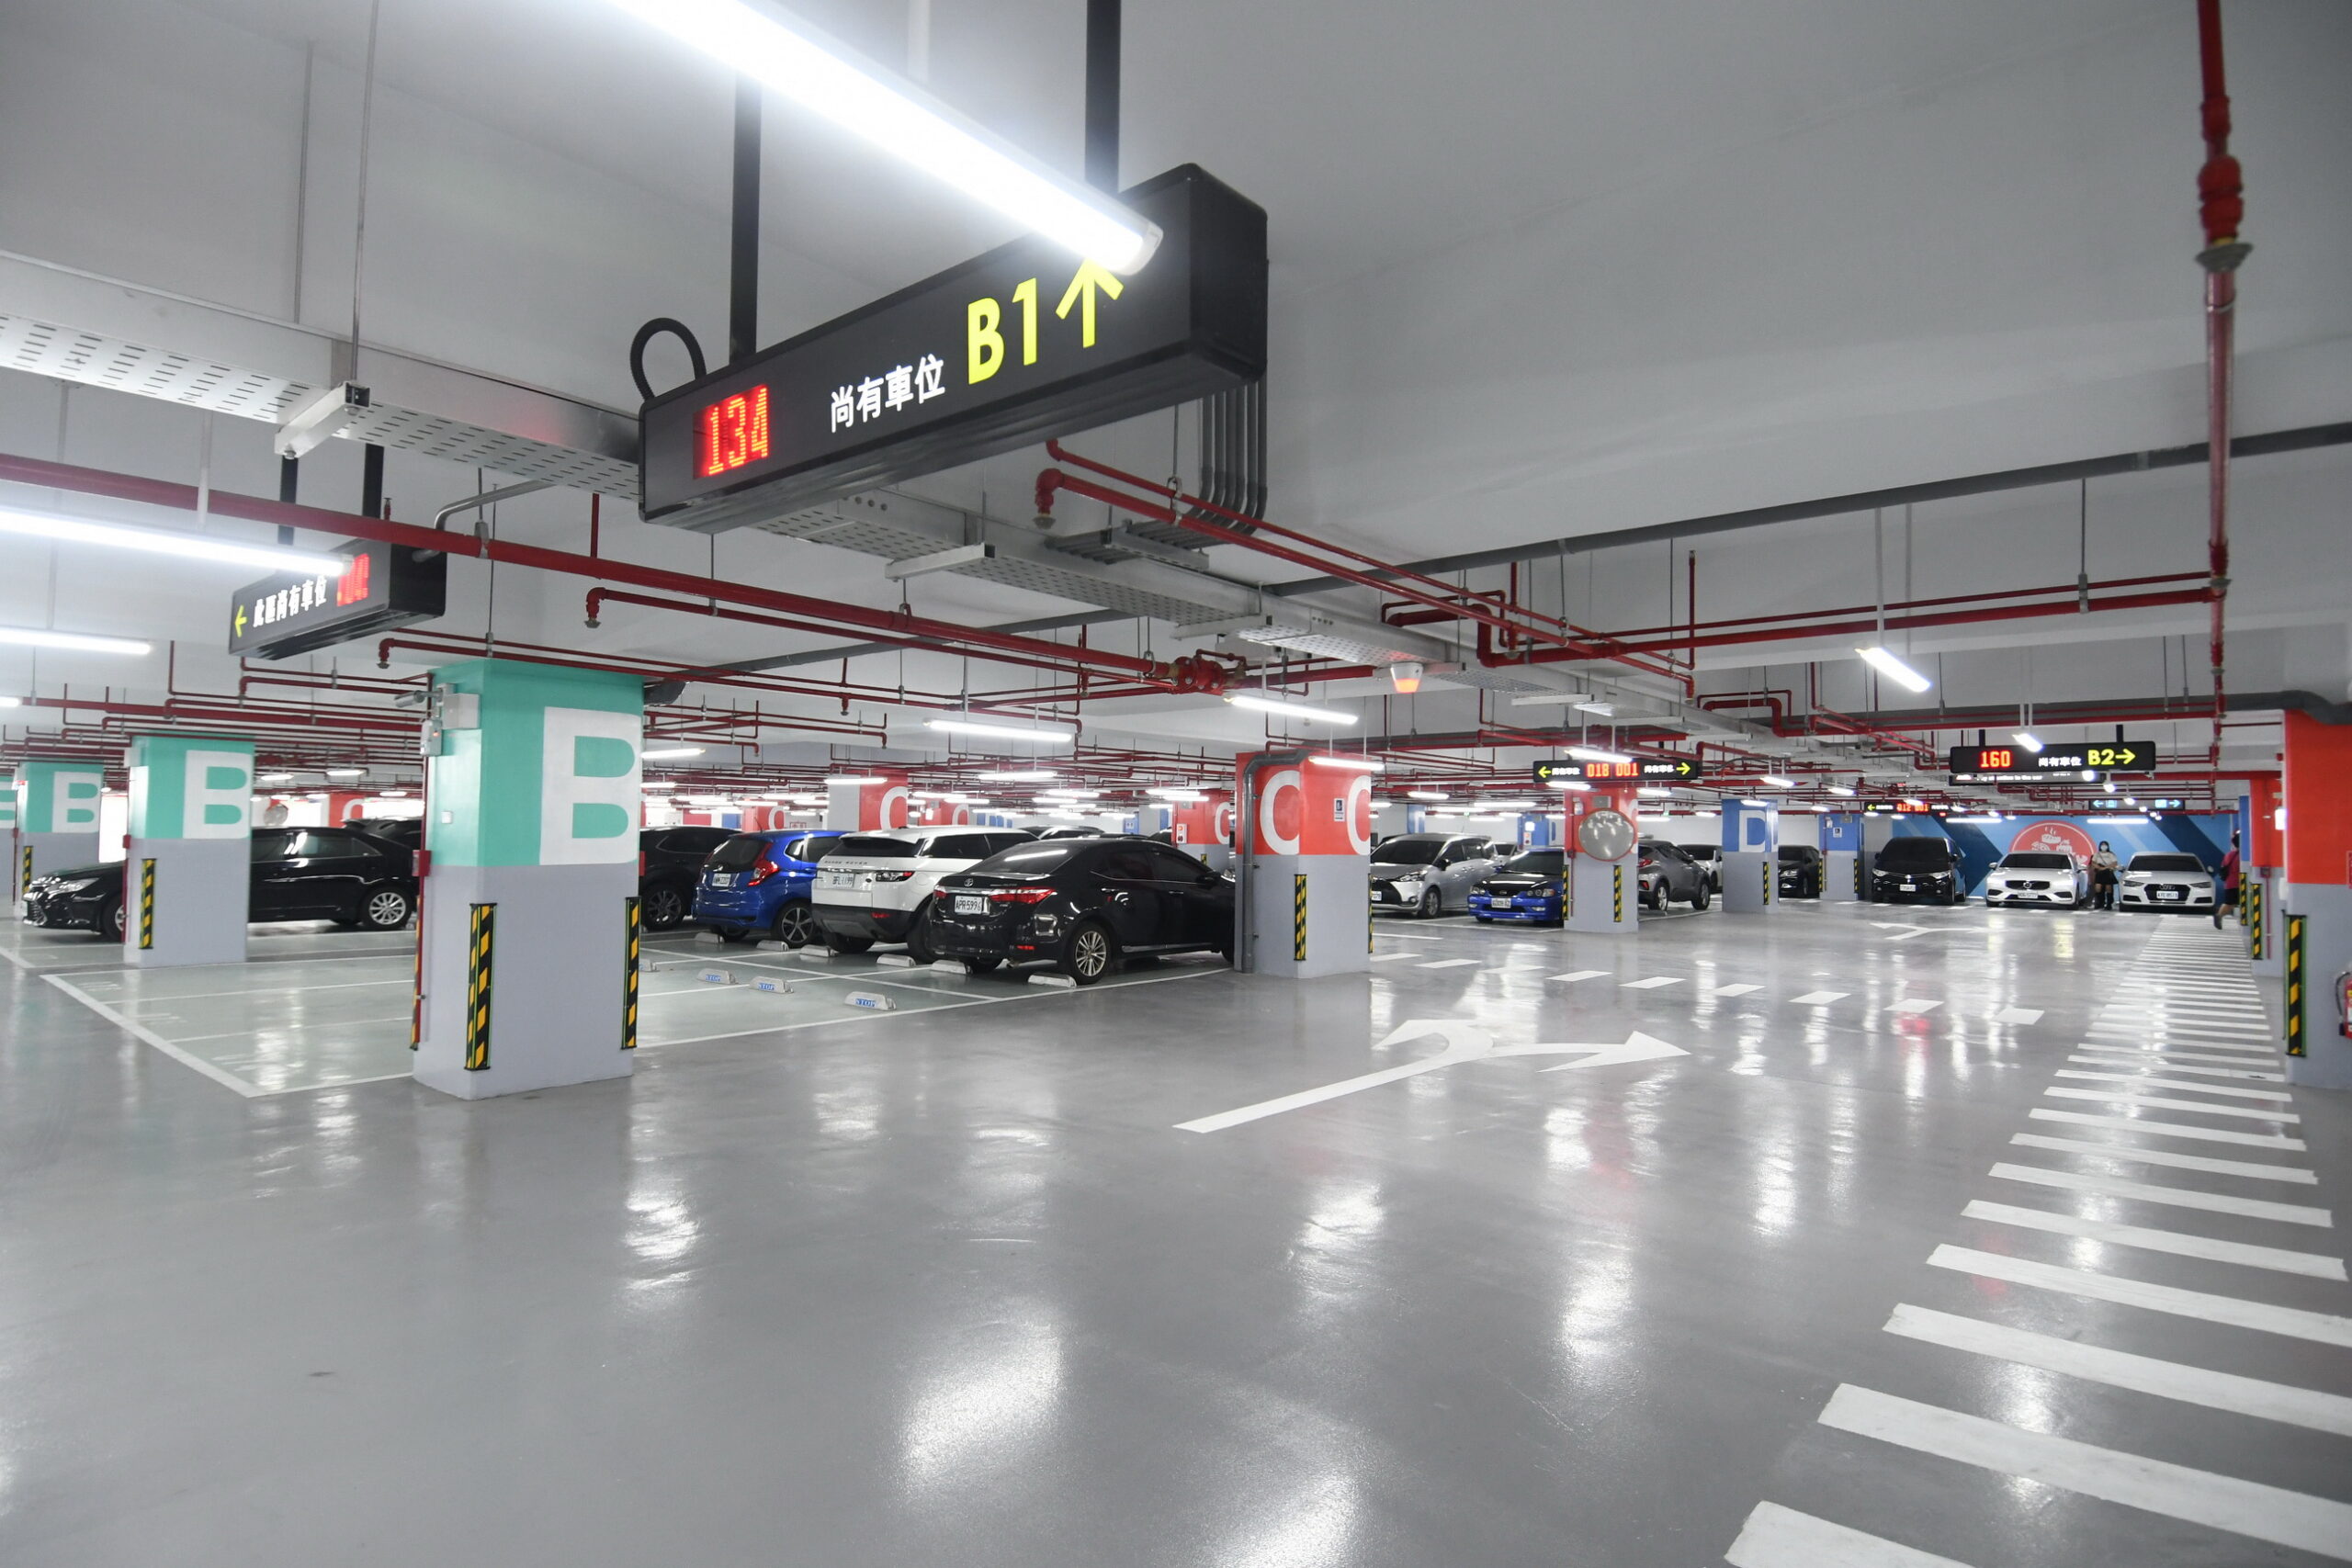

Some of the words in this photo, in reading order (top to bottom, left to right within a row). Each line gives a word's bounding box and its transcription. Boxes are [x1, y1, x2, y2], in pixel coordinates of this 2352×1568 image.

[967, 277, 1037, 385] B1
[708, 386, 768, 476] 134
[830, 354, 946, 434] 尚有車位
[183, 750, 252, 839] B
[539, 706, 642, 865] B
[1980, 750, 2011, 768] 160
[2087, 749, 2115, 765] B2
[52, 772, 102, 833] B
[1260, 770, 1300, 855] C
[1739, 810, 1766, 852] D
[854, 998, 876, 1007] STOP
